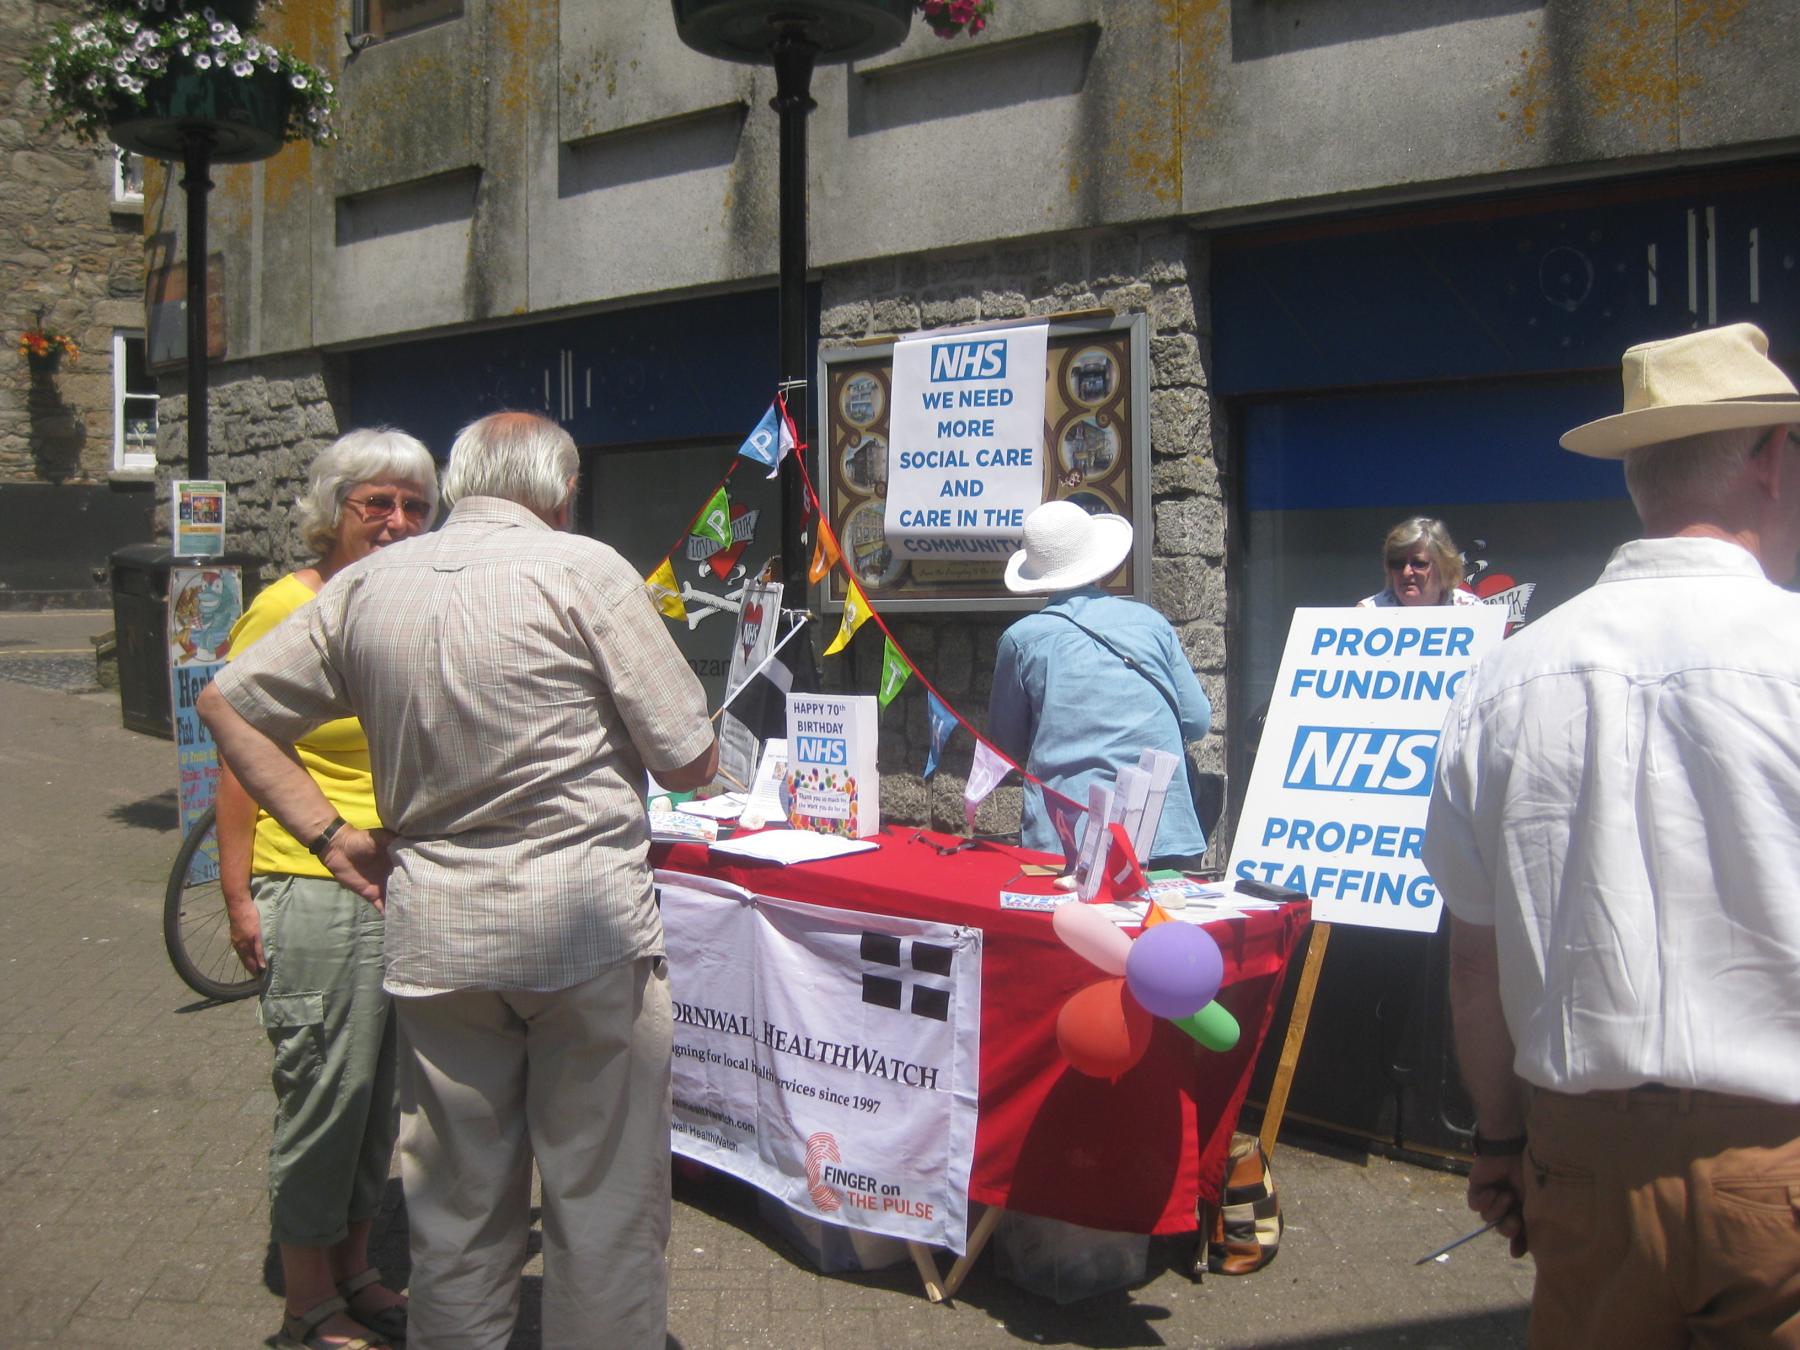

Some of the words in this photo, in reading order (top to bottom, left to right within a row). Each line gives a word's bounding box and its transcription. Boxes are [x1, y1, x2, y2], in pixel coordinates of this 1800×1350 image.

[932, 341, 1006, 380] NHS
[922, 392, 953, 410] WE
[959, 388, 1013, 408] NEED
[937, 419, 995, 438] MORE
[750, 429, 773, 461] P
[900, 451, 969, 470] SOCIAL
[976, 449, 1033, 467] CARE
[940, 480, 984, 497] AND
[706, 509, 726, 541] P
[900, 510, 951, 527] CARE
[958, 510, 976, 527] IN
[984, 509, 1023, 527] THE
[743, 623, 759, 646] NHS
[1311, 627, 1474, 656] PROPER
[886, 660, 902, 696] T
[794, 702, 824, 715] HAPPY
[827, 704, 845, 716] 70th
[797, 721, 844, 734] BIRTHDAY
[799, 738, 844, 763] NHS
[1288, 731, 1437, 791] NHS
[1262, 817, 1426, 859] PROPER
[1235, 860, 1436, 908] STAFFING
[706, 1049, 721, 1065] for
[724, 1053, 748, 1071] local
[818, 1086, 850, 1108] since
[852, 1095, 881, 1114] 1997
[689, 1125, 738, 1152] HealthWatch
[824, 1166, 877, 1193] FINGER
[880, 1182, 901, 1196] on
[847, 1190, 879, 1212] THE
[882, 1197, 934, 1221] PULSE
